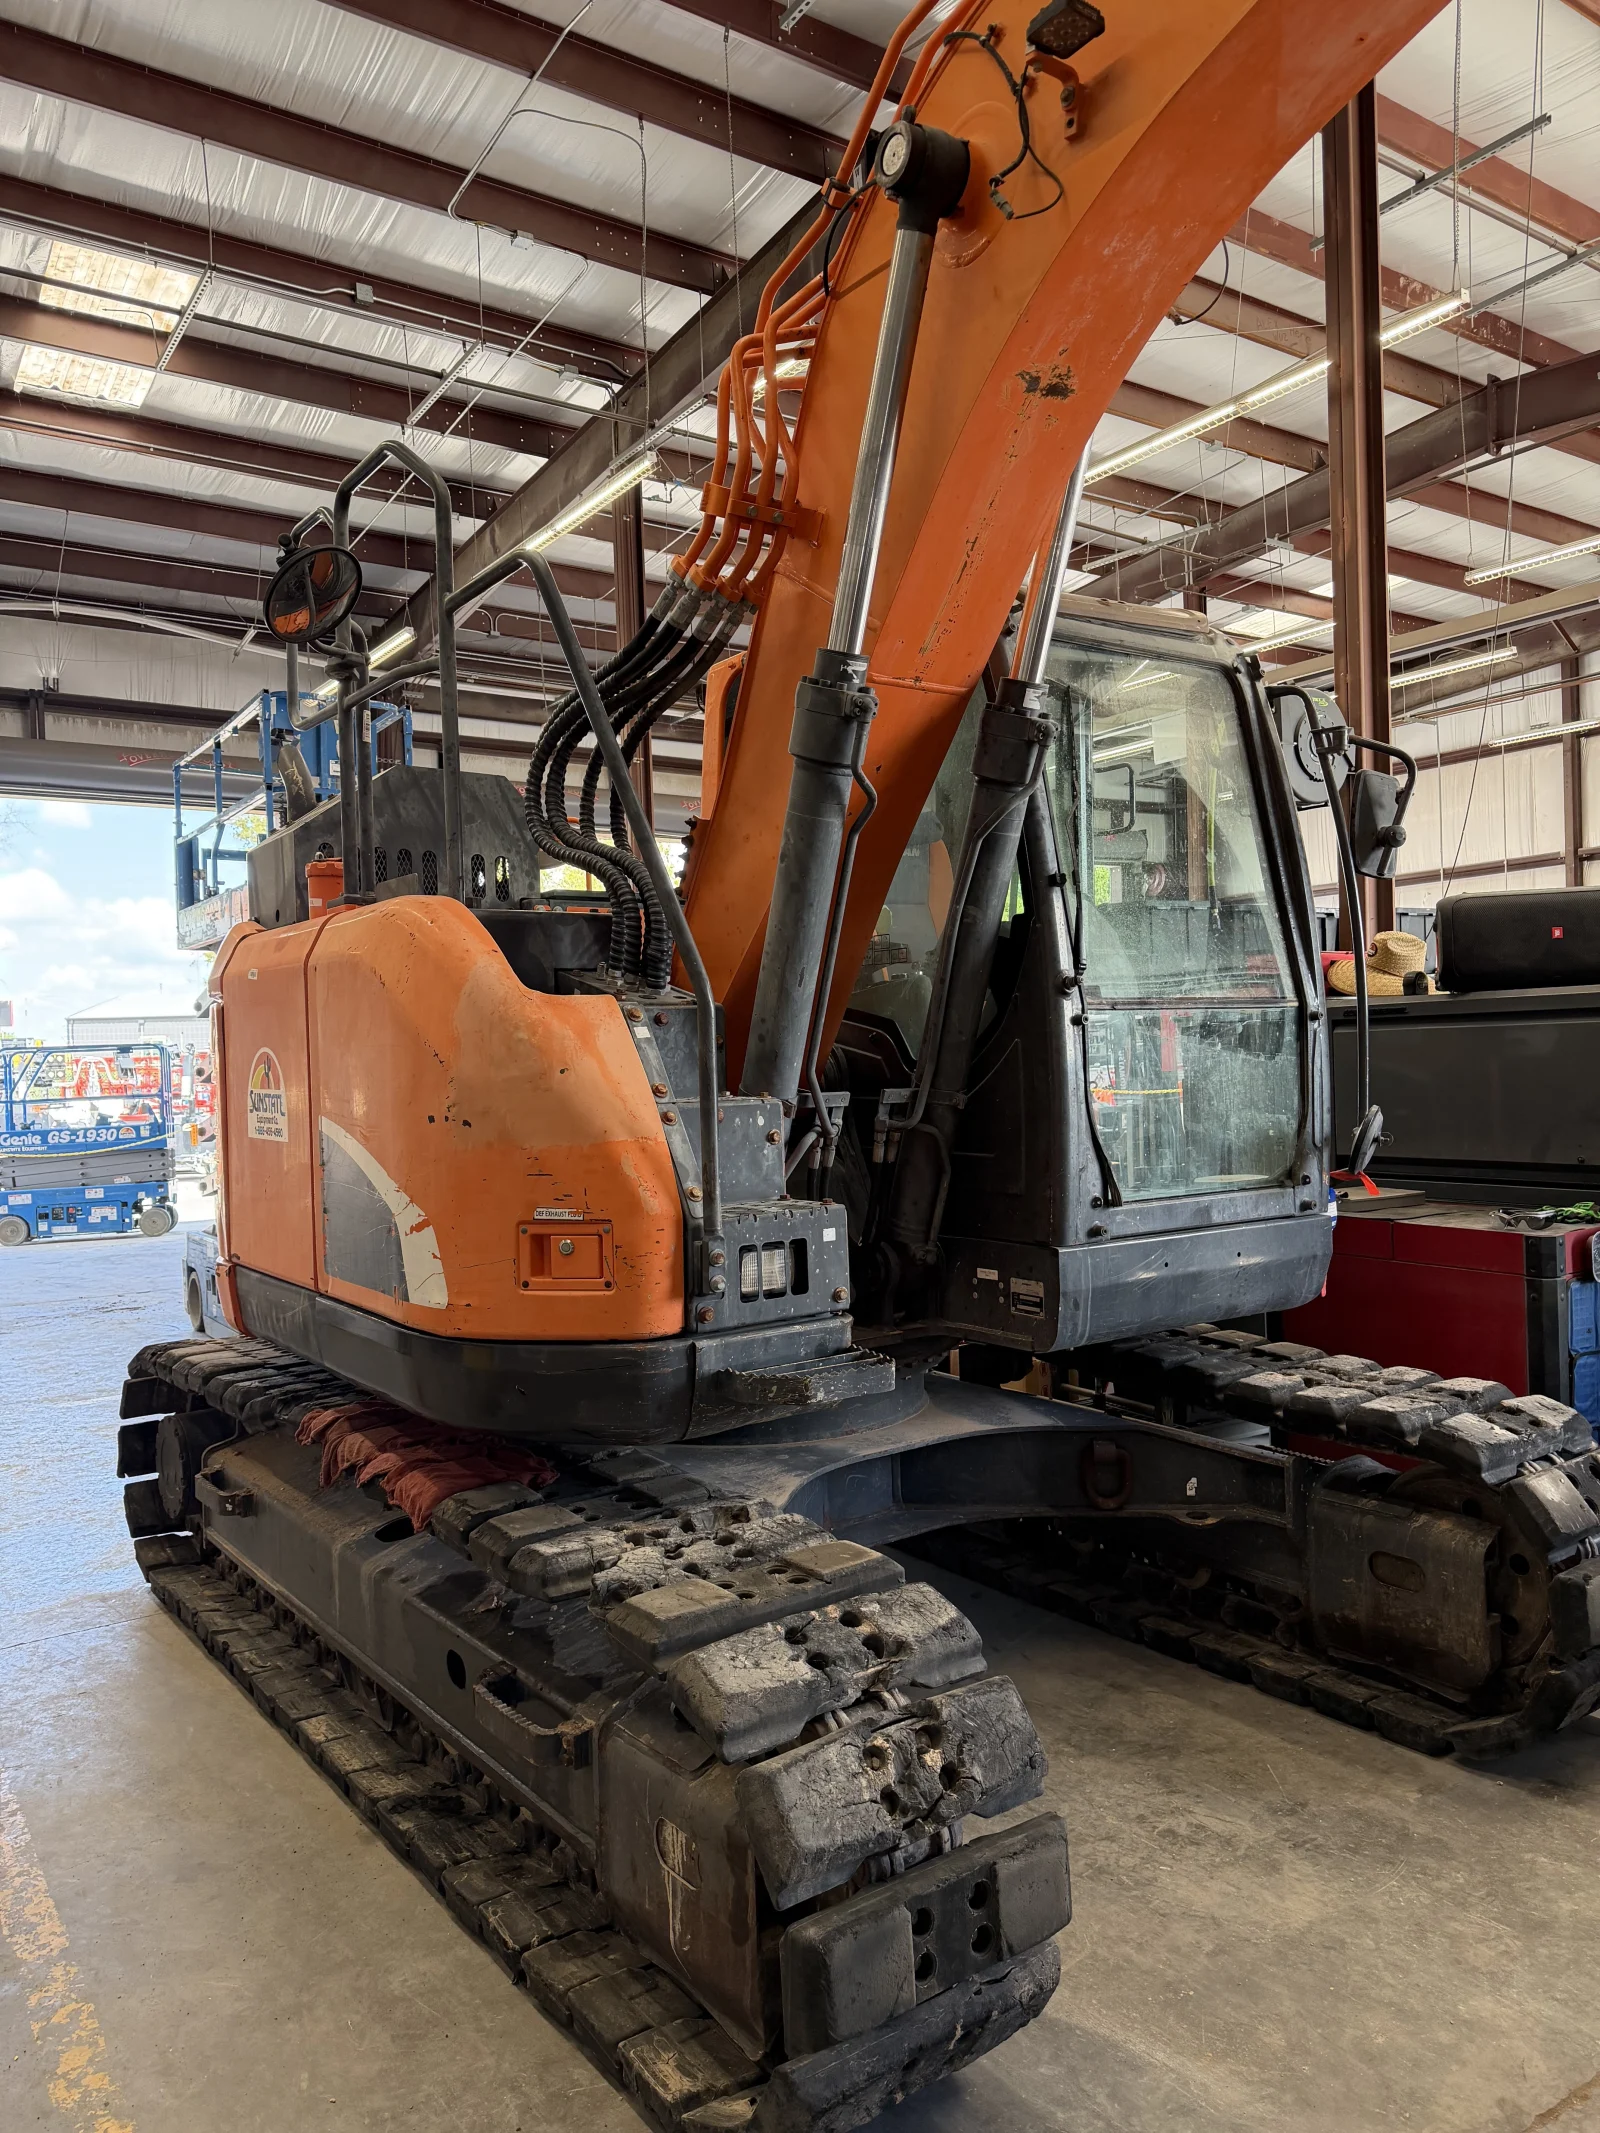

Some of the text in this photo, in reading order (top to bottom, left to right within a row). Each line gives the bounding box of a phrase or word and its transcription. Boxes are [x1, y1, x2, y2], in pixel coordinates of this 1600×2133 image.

[0, 1133, 42, 1146] Genie
[47, 1129, 117, 1144] GS-1930
[545, 1210, 567, 1218] EXHAUST
